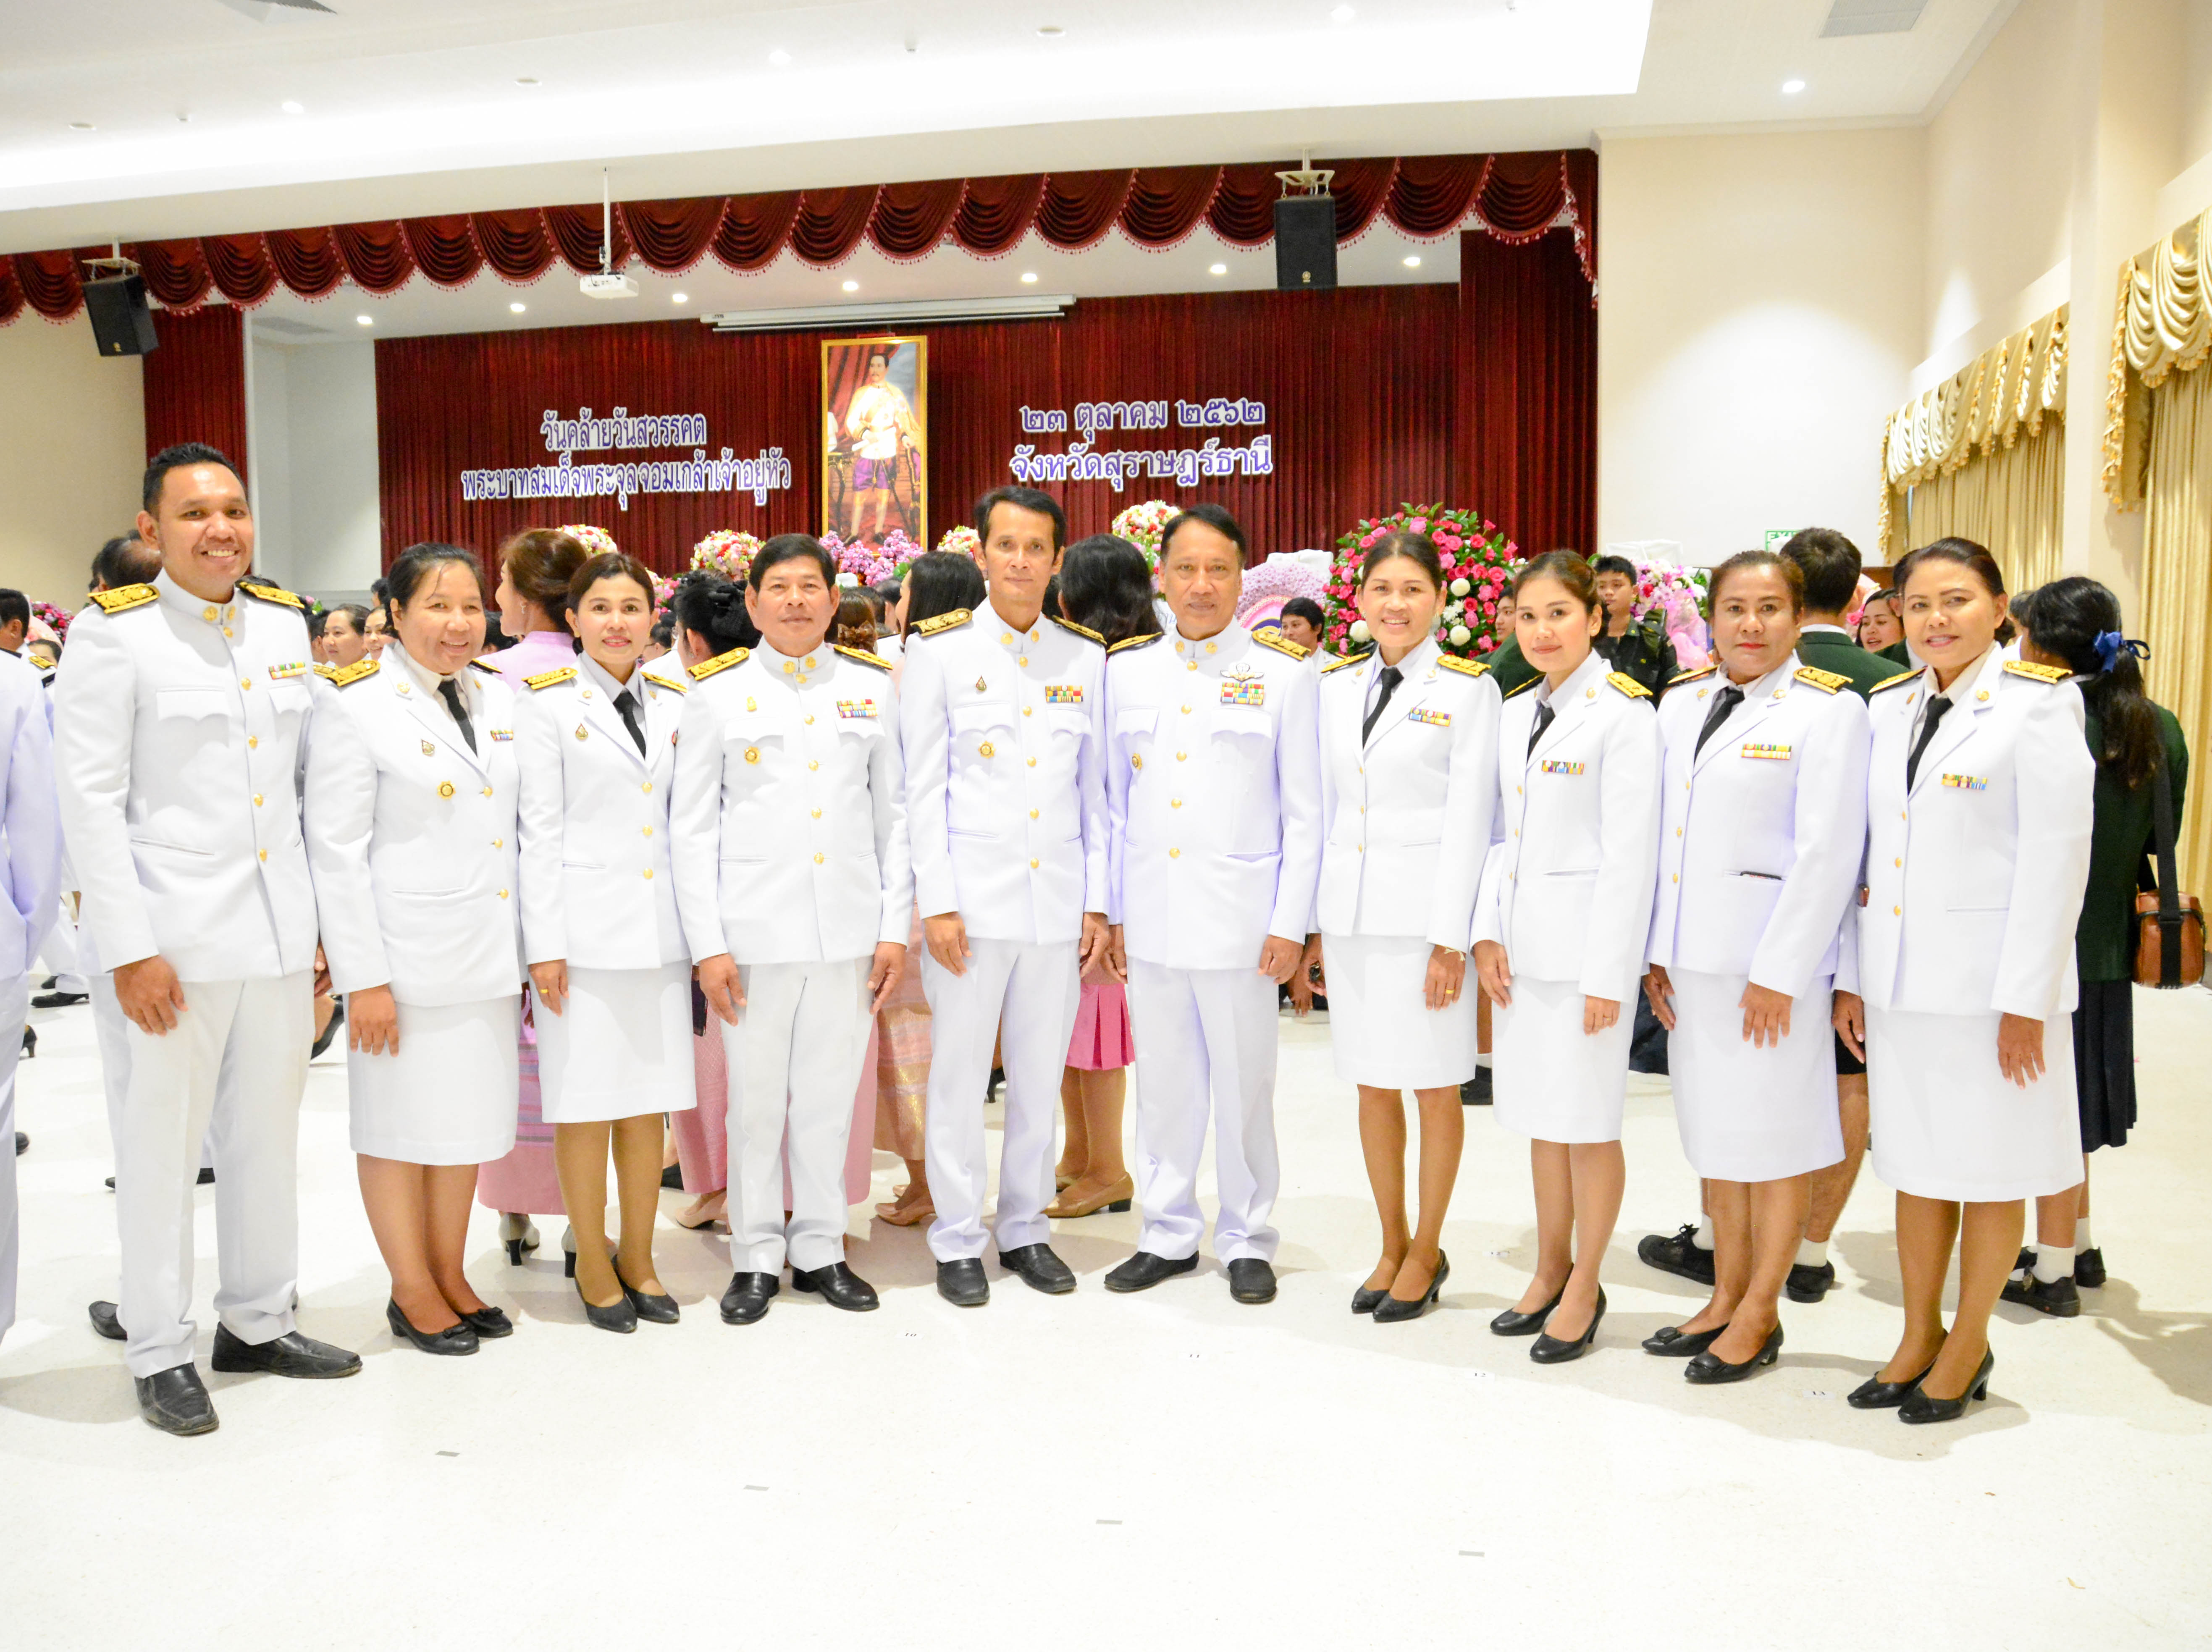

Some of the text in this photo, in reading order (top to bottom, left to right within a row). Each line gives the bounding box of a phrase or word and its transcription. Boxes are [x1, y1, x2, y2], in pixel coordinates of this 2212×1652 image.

[541, 406, 706, 452] วันคล้ายวันสวรรคต
[1019, 397, 1265, 444] ๒๓ ตุลาคม ๒๕๖๒
[461, 447, 791, 511] พระบาทสมเด็จพระจุลจอมเกล้าเจ้าอยู่หัว
[1009, 434, 1273, 492] จังหวัดสุราษฎร์ธานี
